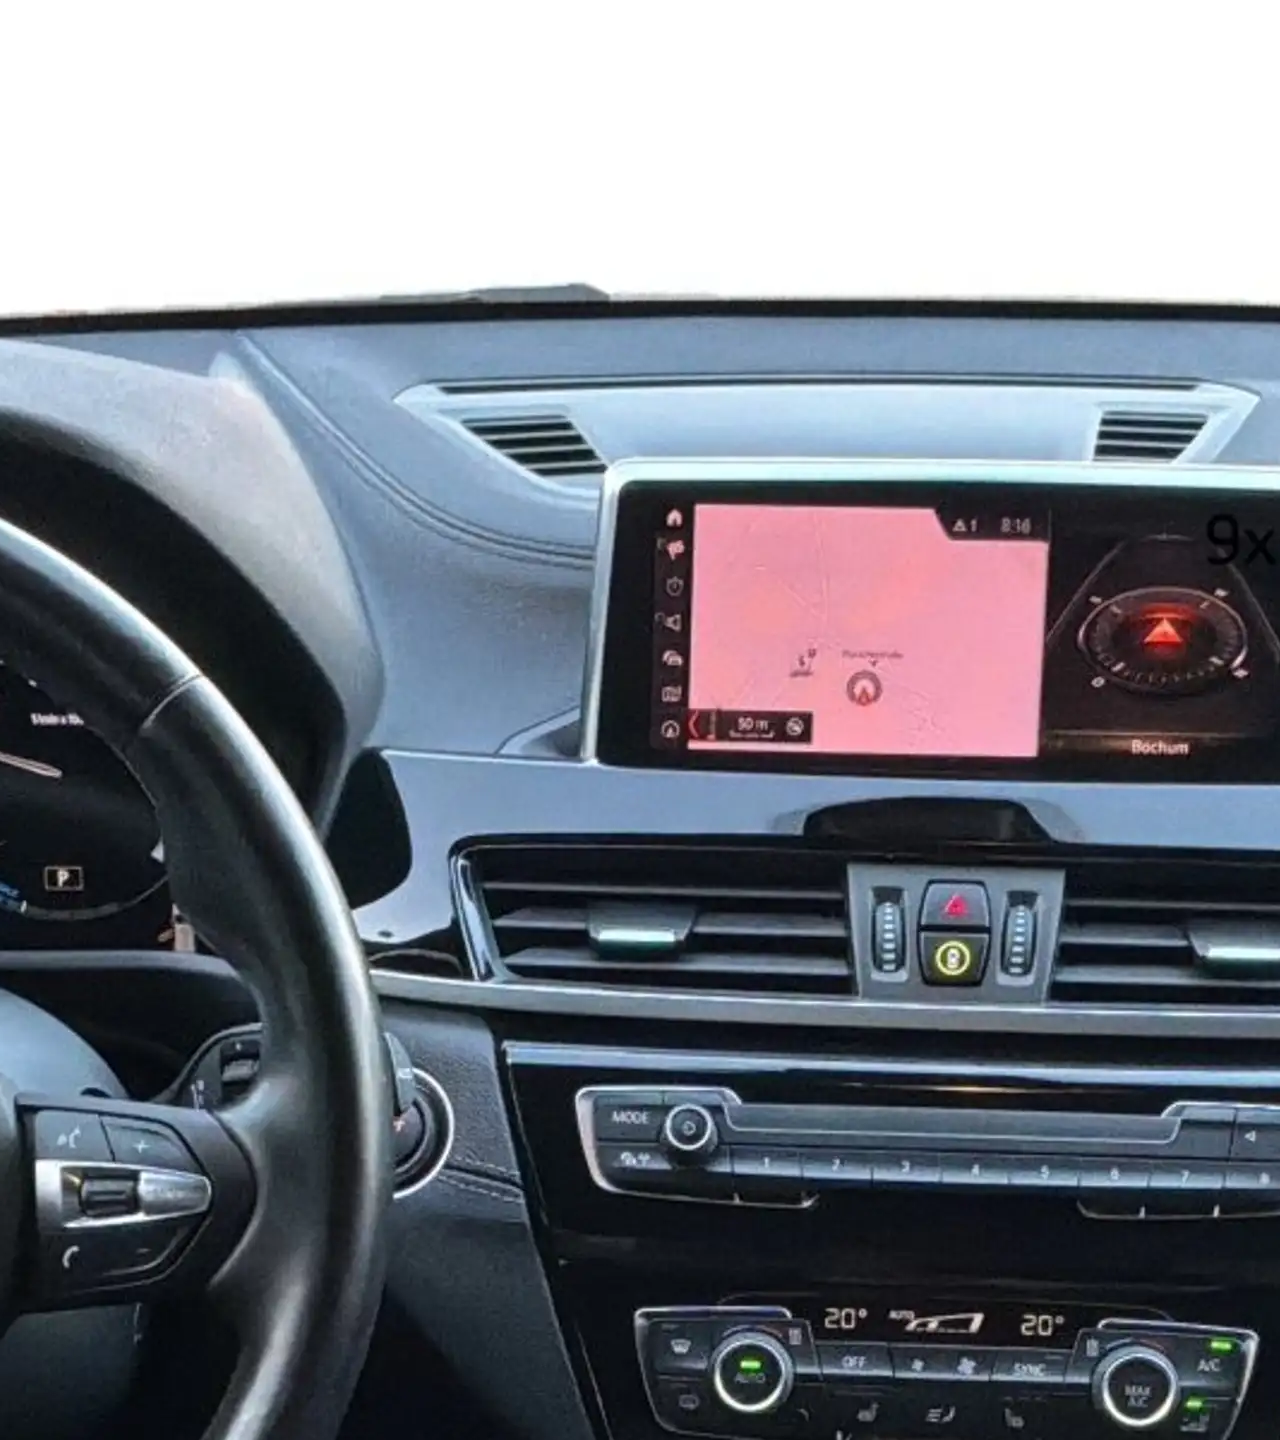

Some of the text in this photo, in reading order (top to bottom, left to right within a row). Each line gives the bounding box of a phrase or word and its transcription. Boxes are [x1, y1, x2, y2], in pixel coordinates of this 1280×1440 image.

[1131, 739, 1189, 755] Bochum
[57, 870, 70, 888] P
[612, 1111, 649, 1124] MODE
[824, 1307, 868, 1329] 20°
[1020, 1314, 1065, 1337] 20°
[841, 1356, 867, 1368] OFF
[1197, 1359, 1221, 1373] A/C
